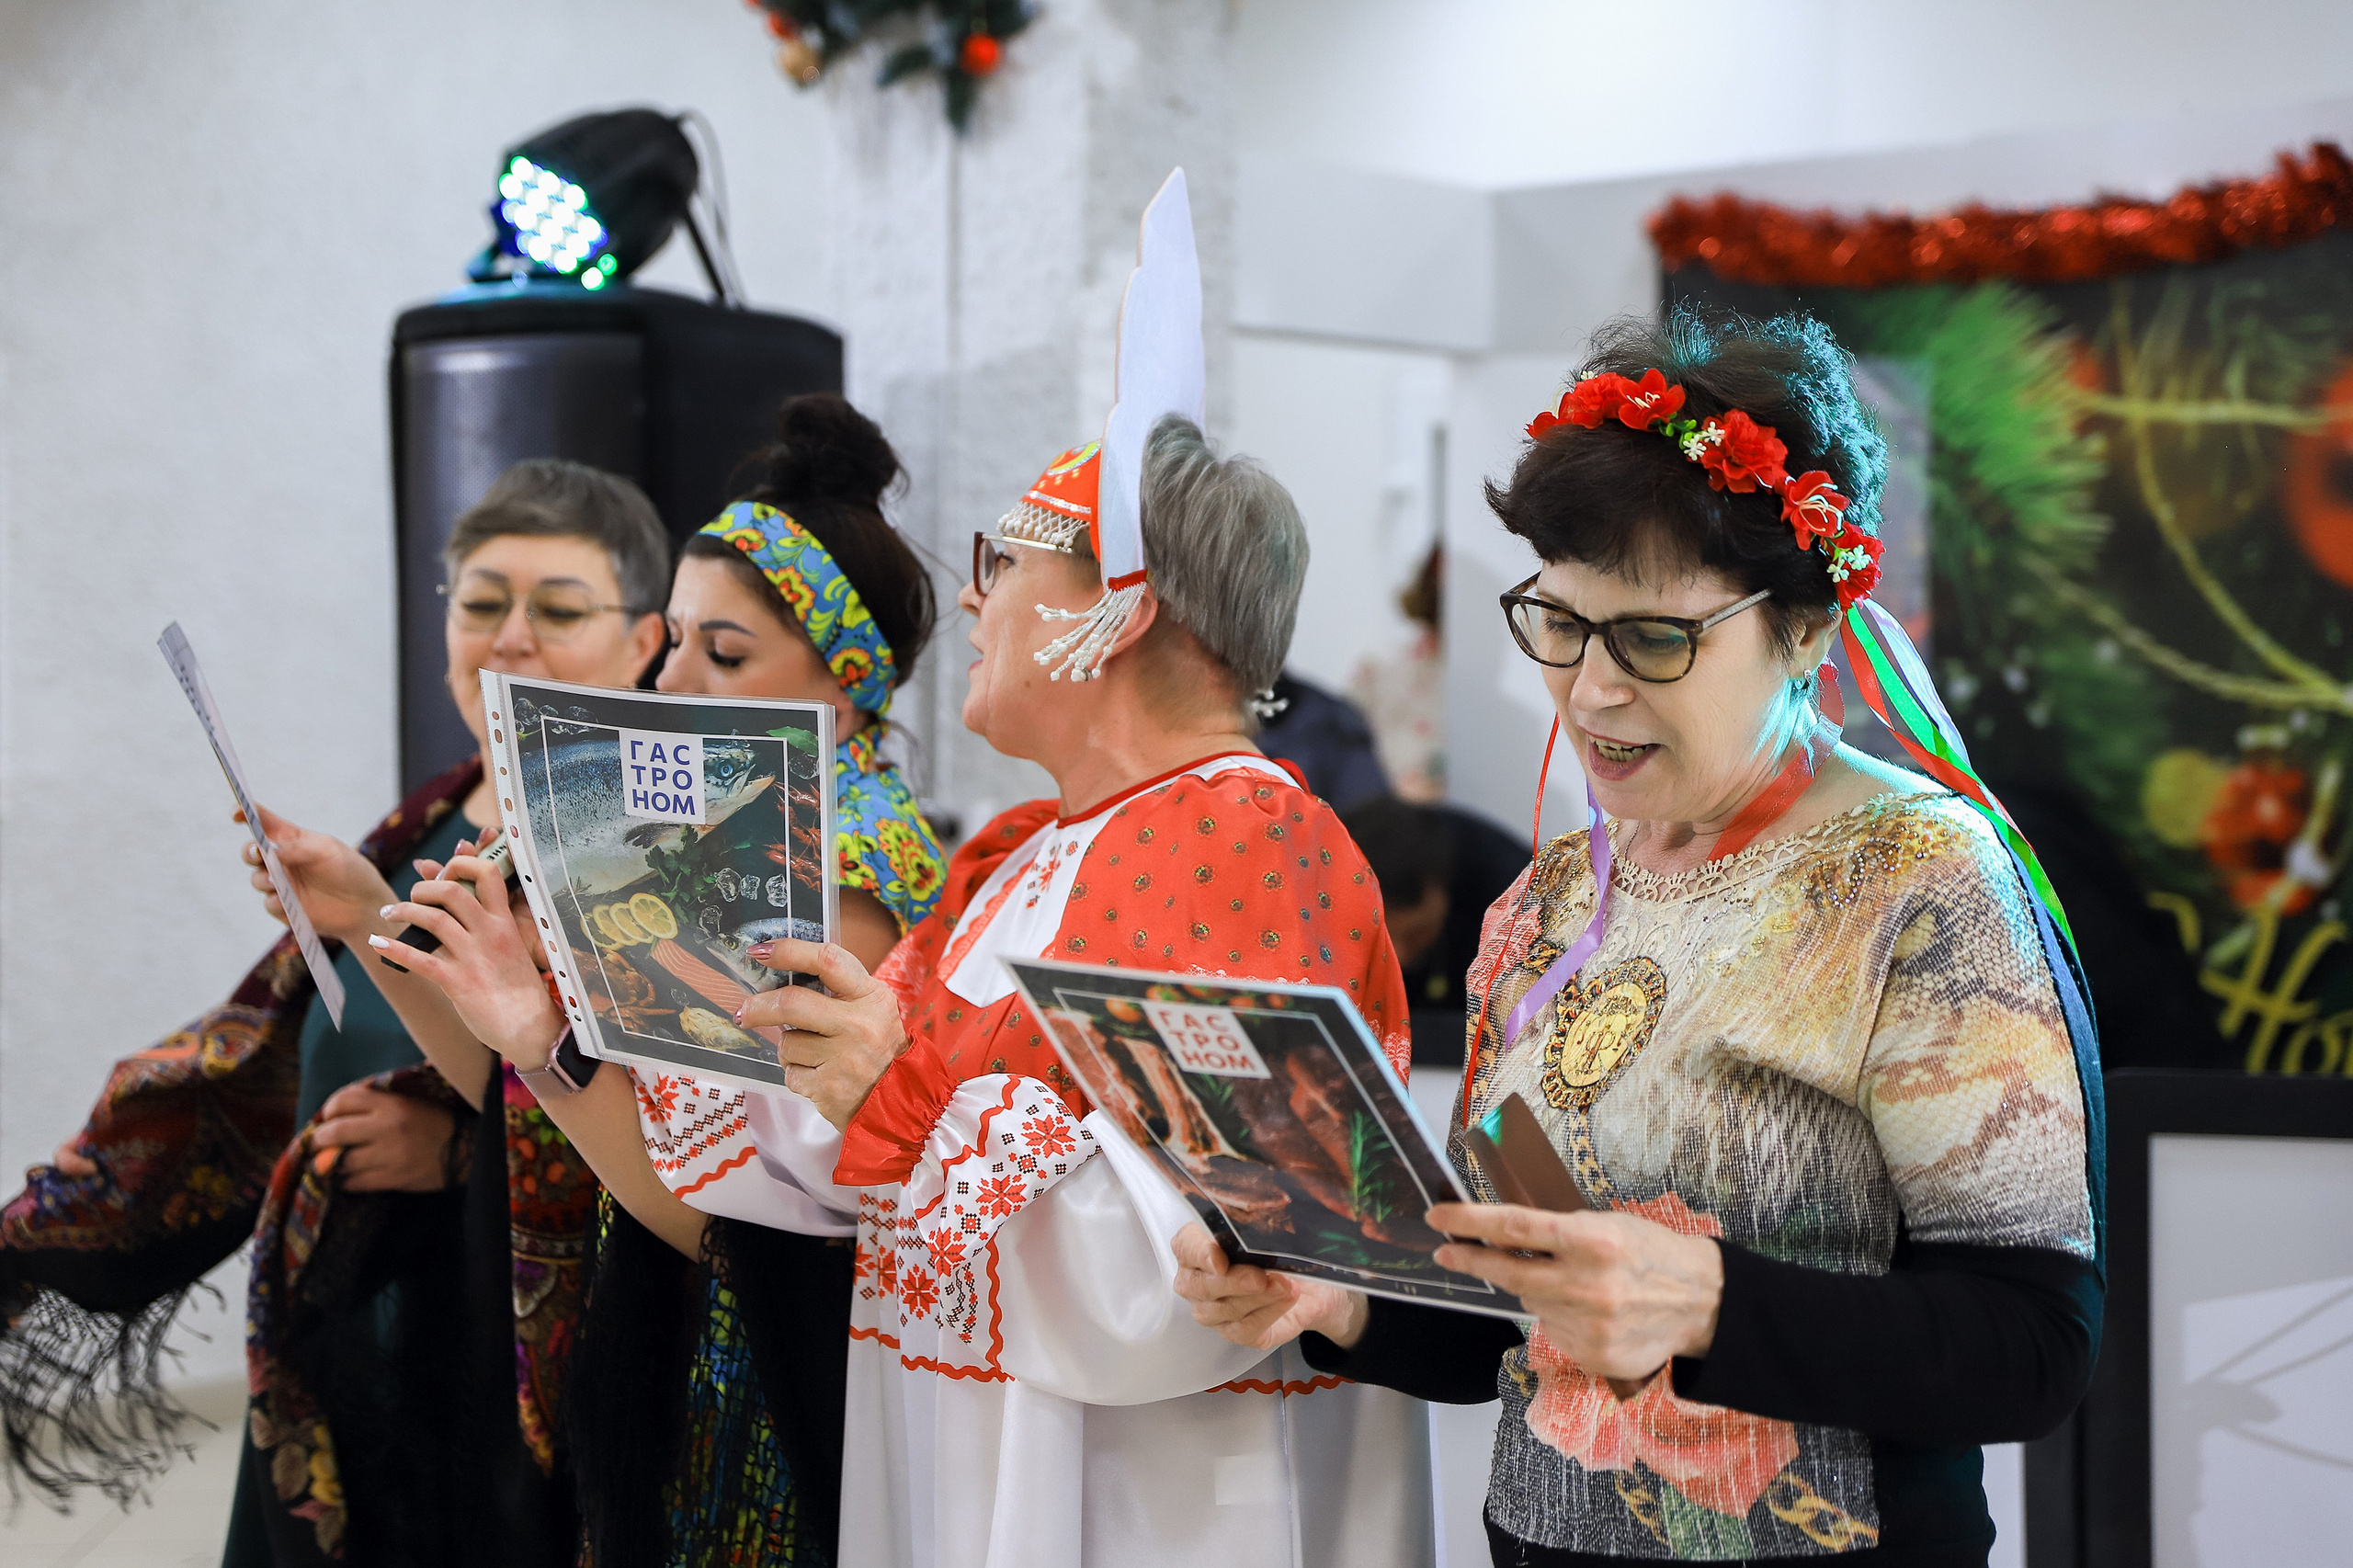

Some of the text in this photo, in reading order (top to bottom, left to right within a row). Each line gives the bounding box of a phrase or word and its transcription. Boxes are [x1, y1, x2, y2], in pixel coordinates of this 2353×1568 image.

[631, 740, 690, 766] ГАС
[631, 764, 693, 790] ТРО
[632, 789, 696, 816] НОМ
[1158, 1011, 1230, 1032] ГАС
[1169, 1030, 1241, 1051] ТРО
[1181, 1050, 1256, 1071] НОМ
